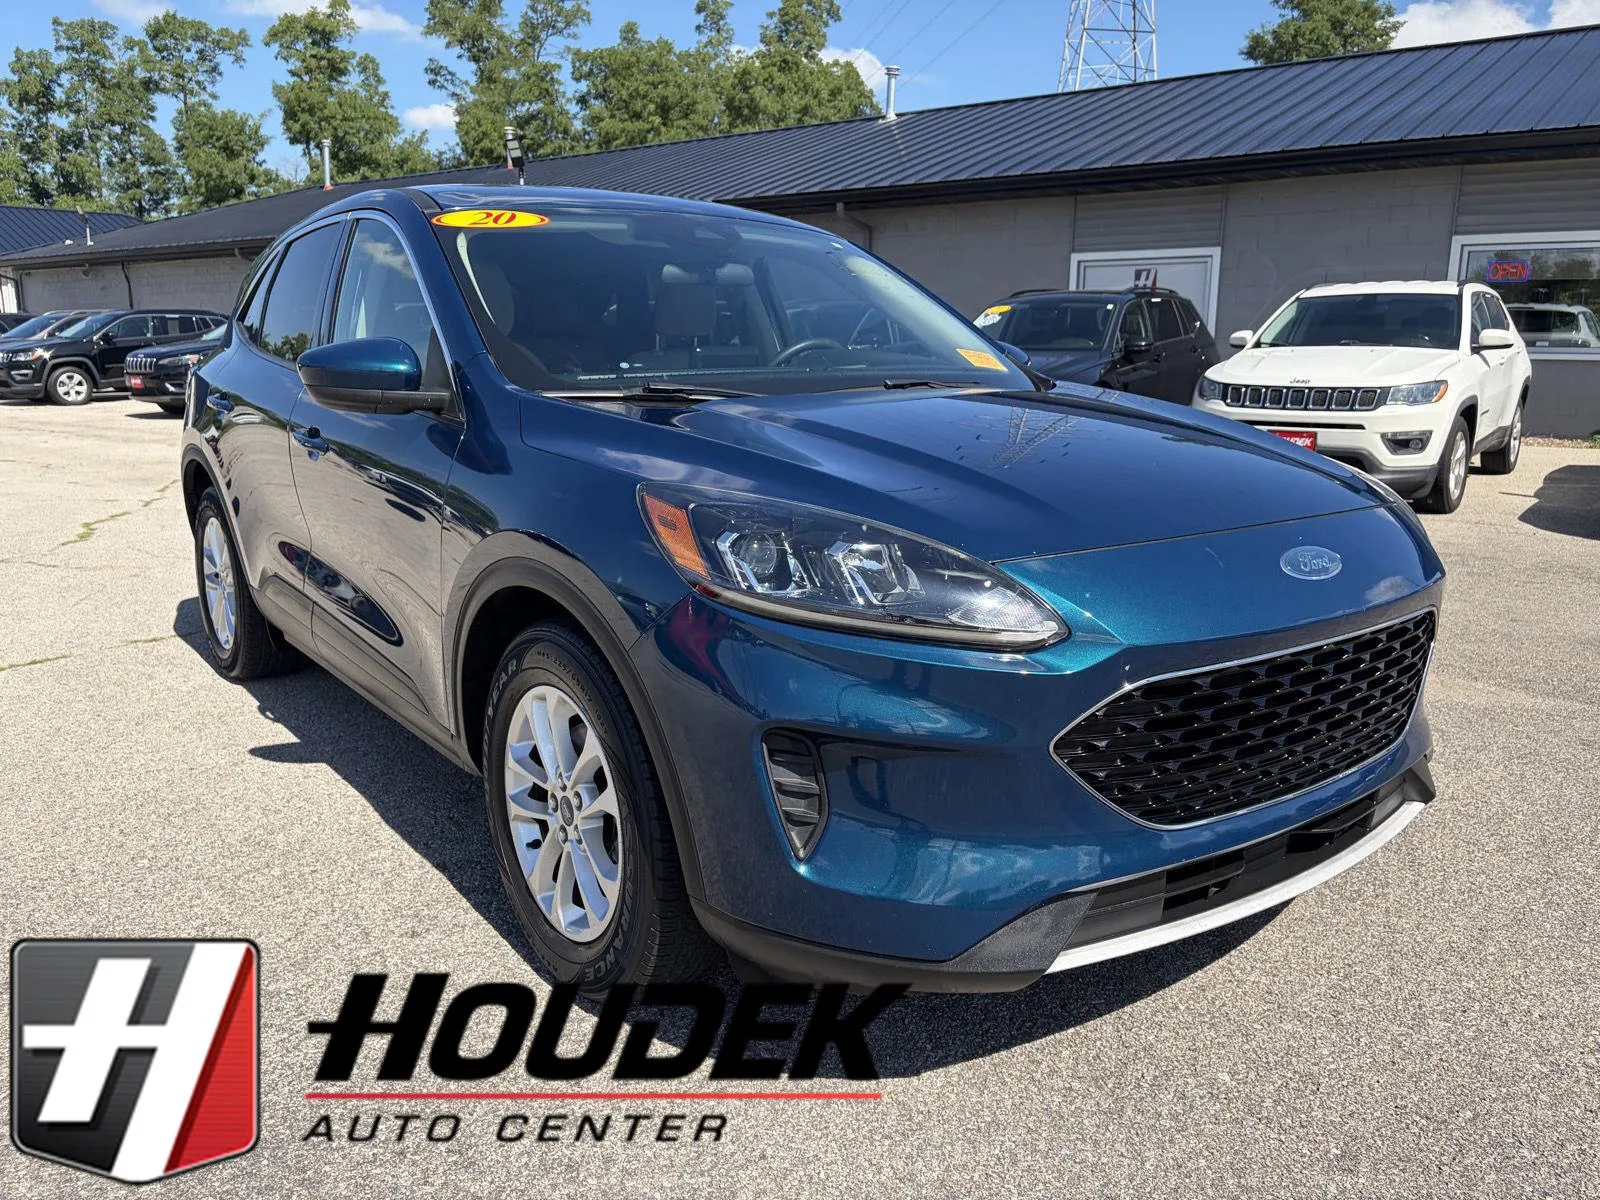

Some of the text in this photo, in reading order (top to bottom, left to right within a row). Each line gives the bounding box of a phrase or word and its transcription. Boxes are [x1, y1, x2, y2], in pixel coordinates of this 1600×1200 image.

[468, 211, 517, 226] 20
[1489, 262, 1528, 281] OPEN
[1289, 377, 1311, 386] Jeep
[1299, 552, 1332, 572] Ford
